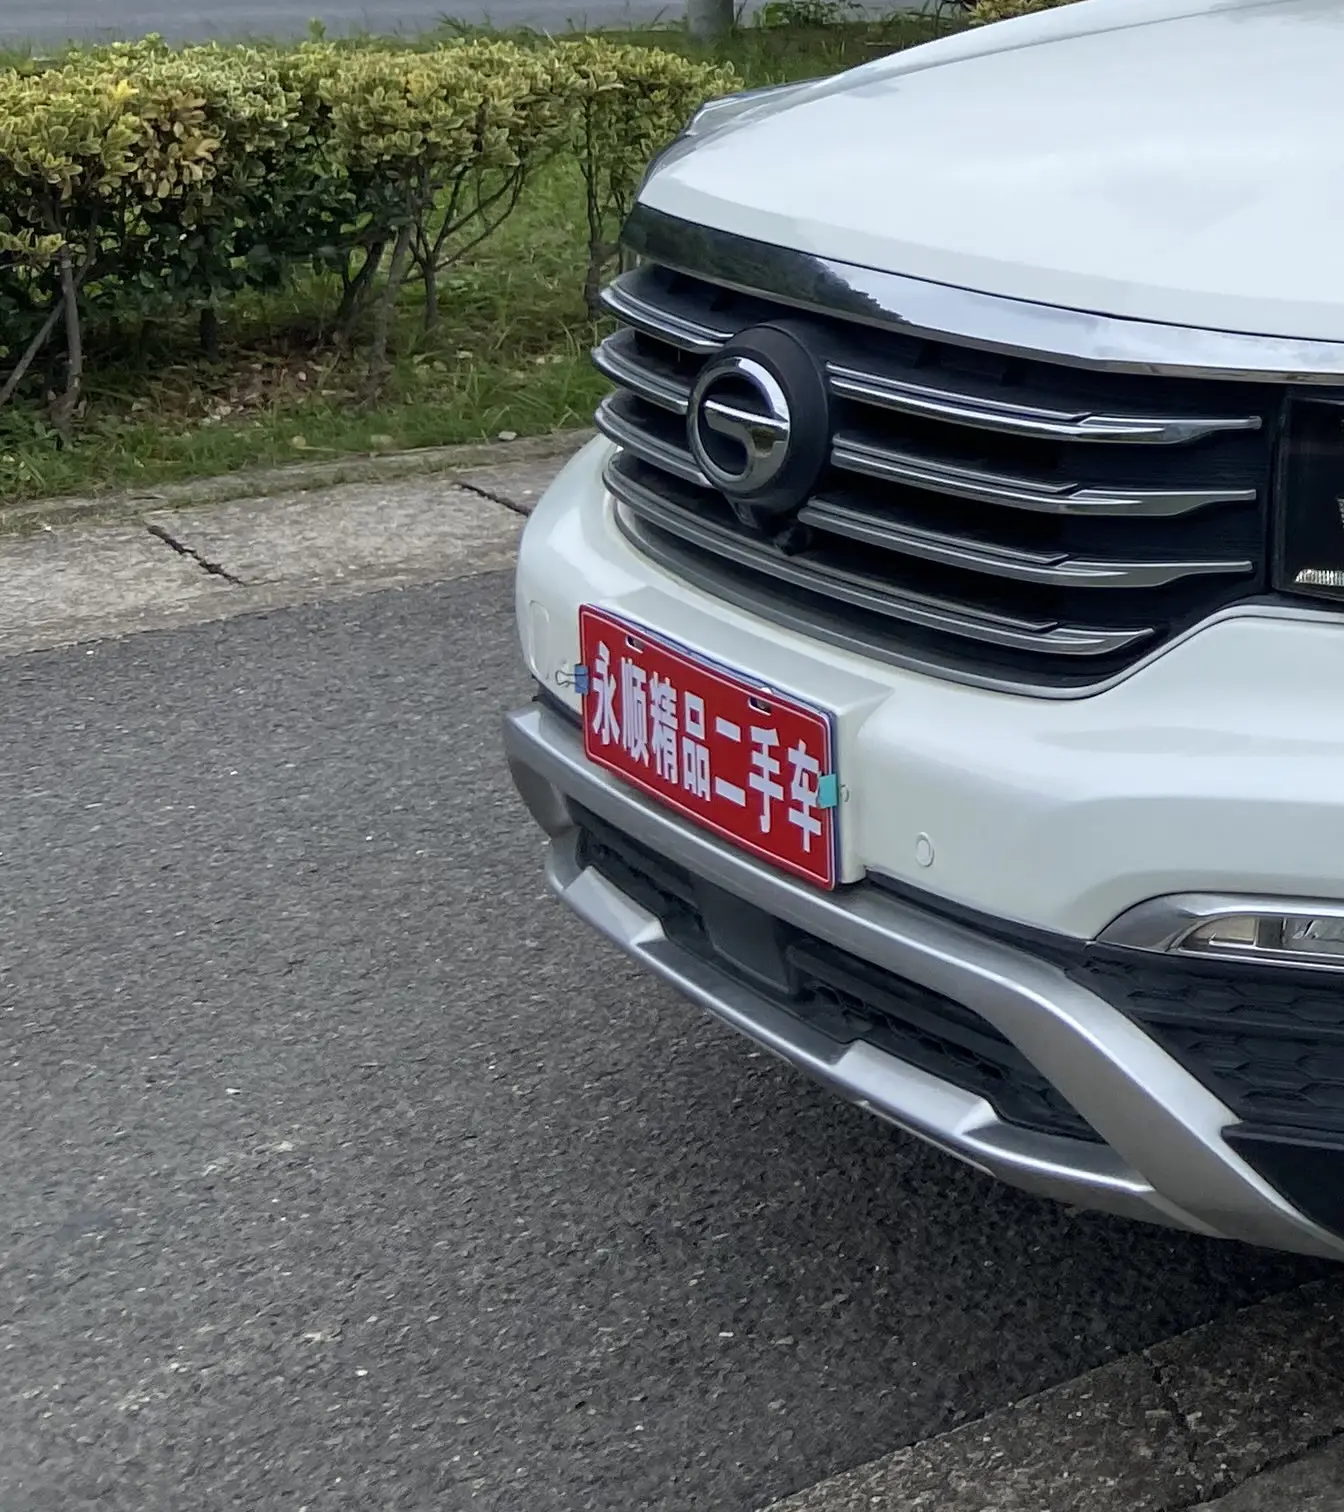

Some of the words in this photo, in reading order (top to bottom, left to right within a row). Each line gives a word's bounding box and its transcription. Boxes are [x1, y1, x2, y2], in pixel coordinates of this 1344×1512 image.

[591, 639, 823, 854] 永顺精品二手车
